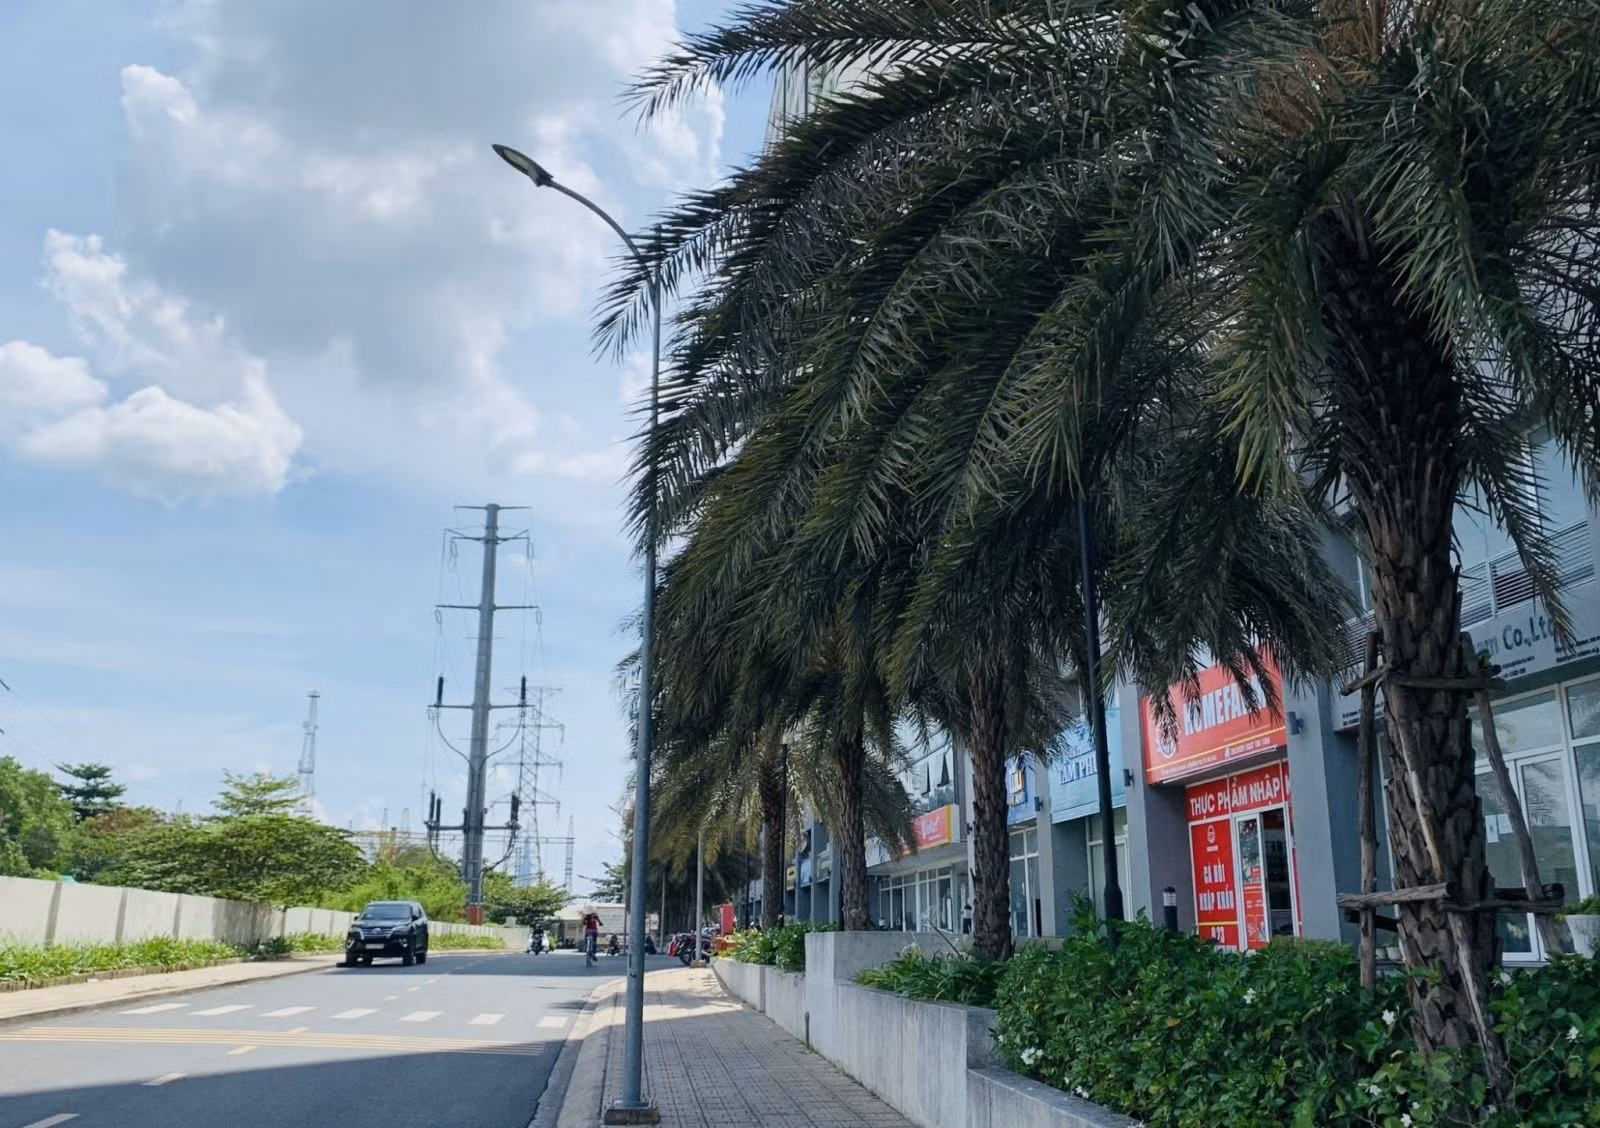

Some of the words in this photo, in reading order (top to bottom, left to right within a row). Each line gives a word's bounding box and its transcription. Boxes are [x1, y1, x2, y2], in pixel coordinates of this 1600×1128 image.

[1190, 792, 1215, 819] THỰC
[1217, 777, 1248, 811] PHẨM
[1250, 773, 1280, 805] NHẬP
